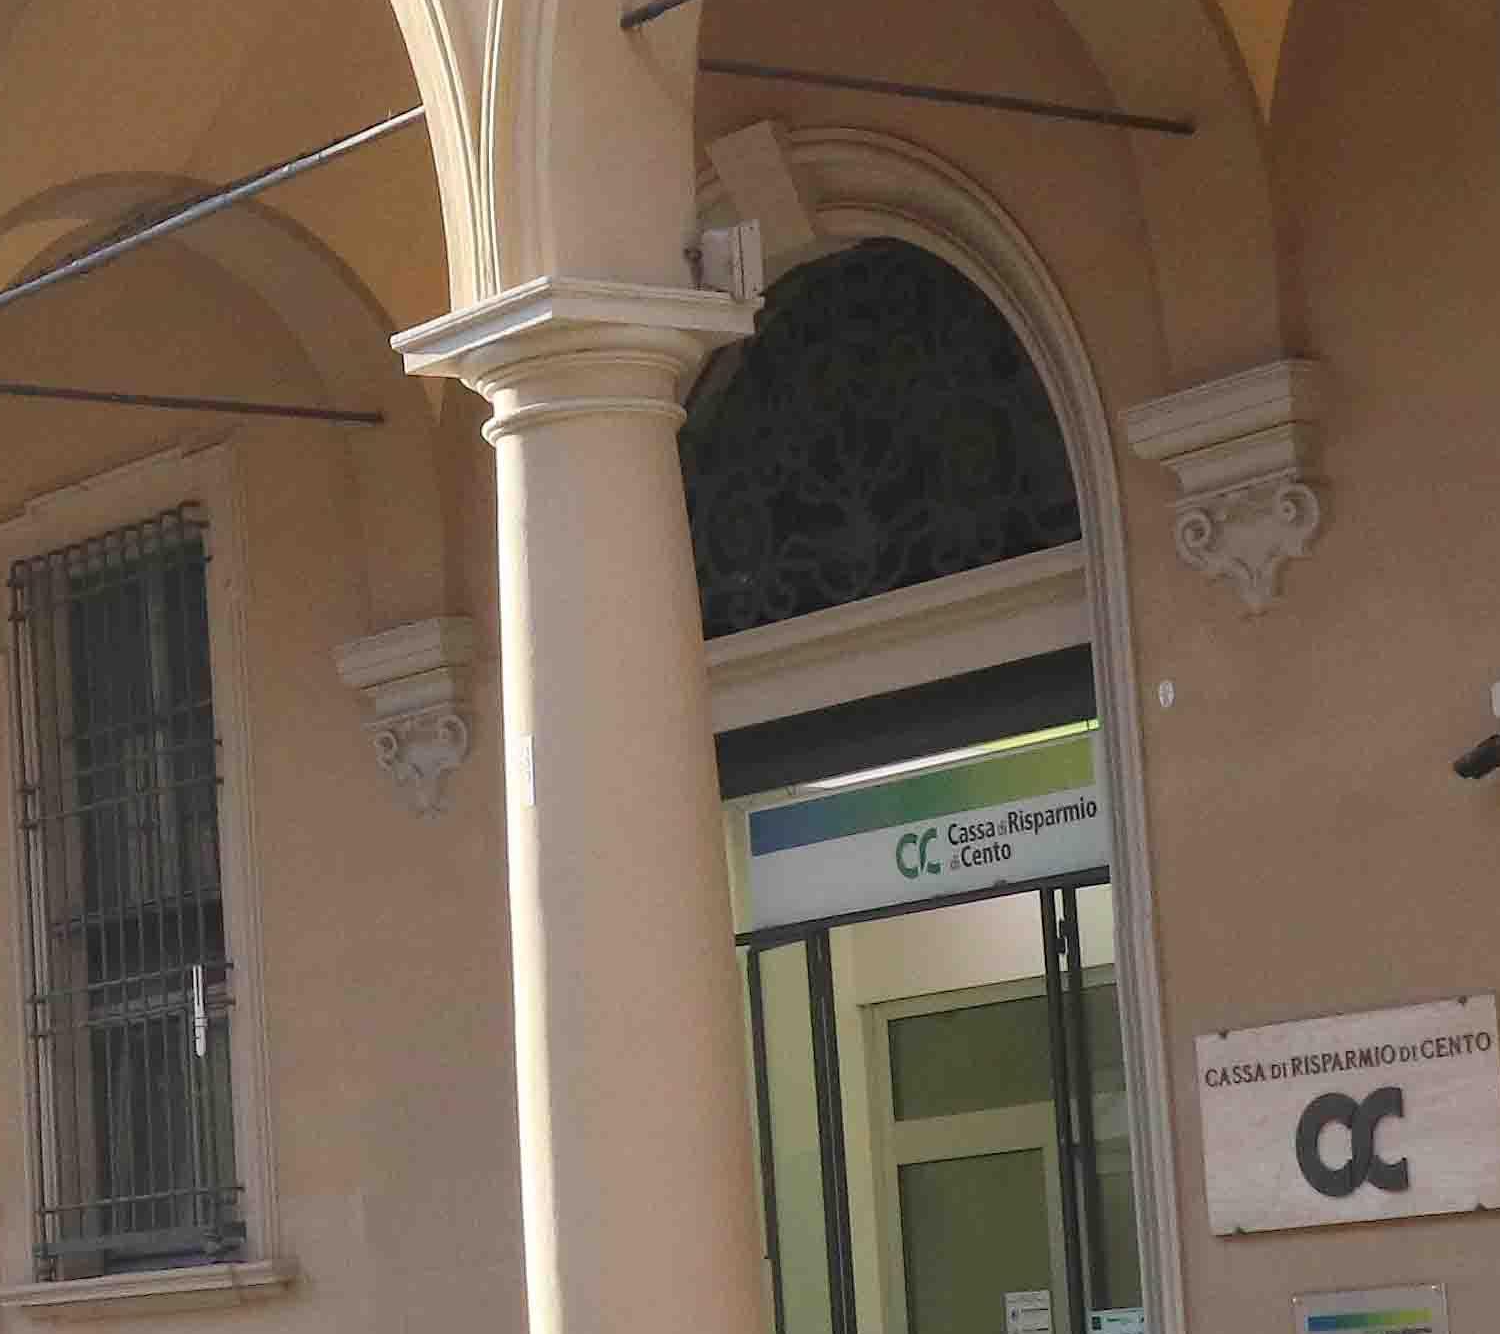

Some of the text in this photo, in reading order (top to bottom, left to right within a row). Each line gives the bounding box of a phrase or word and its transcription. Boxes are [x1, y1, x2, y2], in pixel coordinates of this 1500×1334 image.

[947, 819, 996, 847] Cassa
[1007, 795, 1098, 836] Risparmio
[961, 841, 1012, 869] Cento
[1205, 1063, 1266, 1088] CASSA
[1292, 1043, 1398, 1078] RISPARMIO
[1421, 1031, 1492, 1059] CENTO
